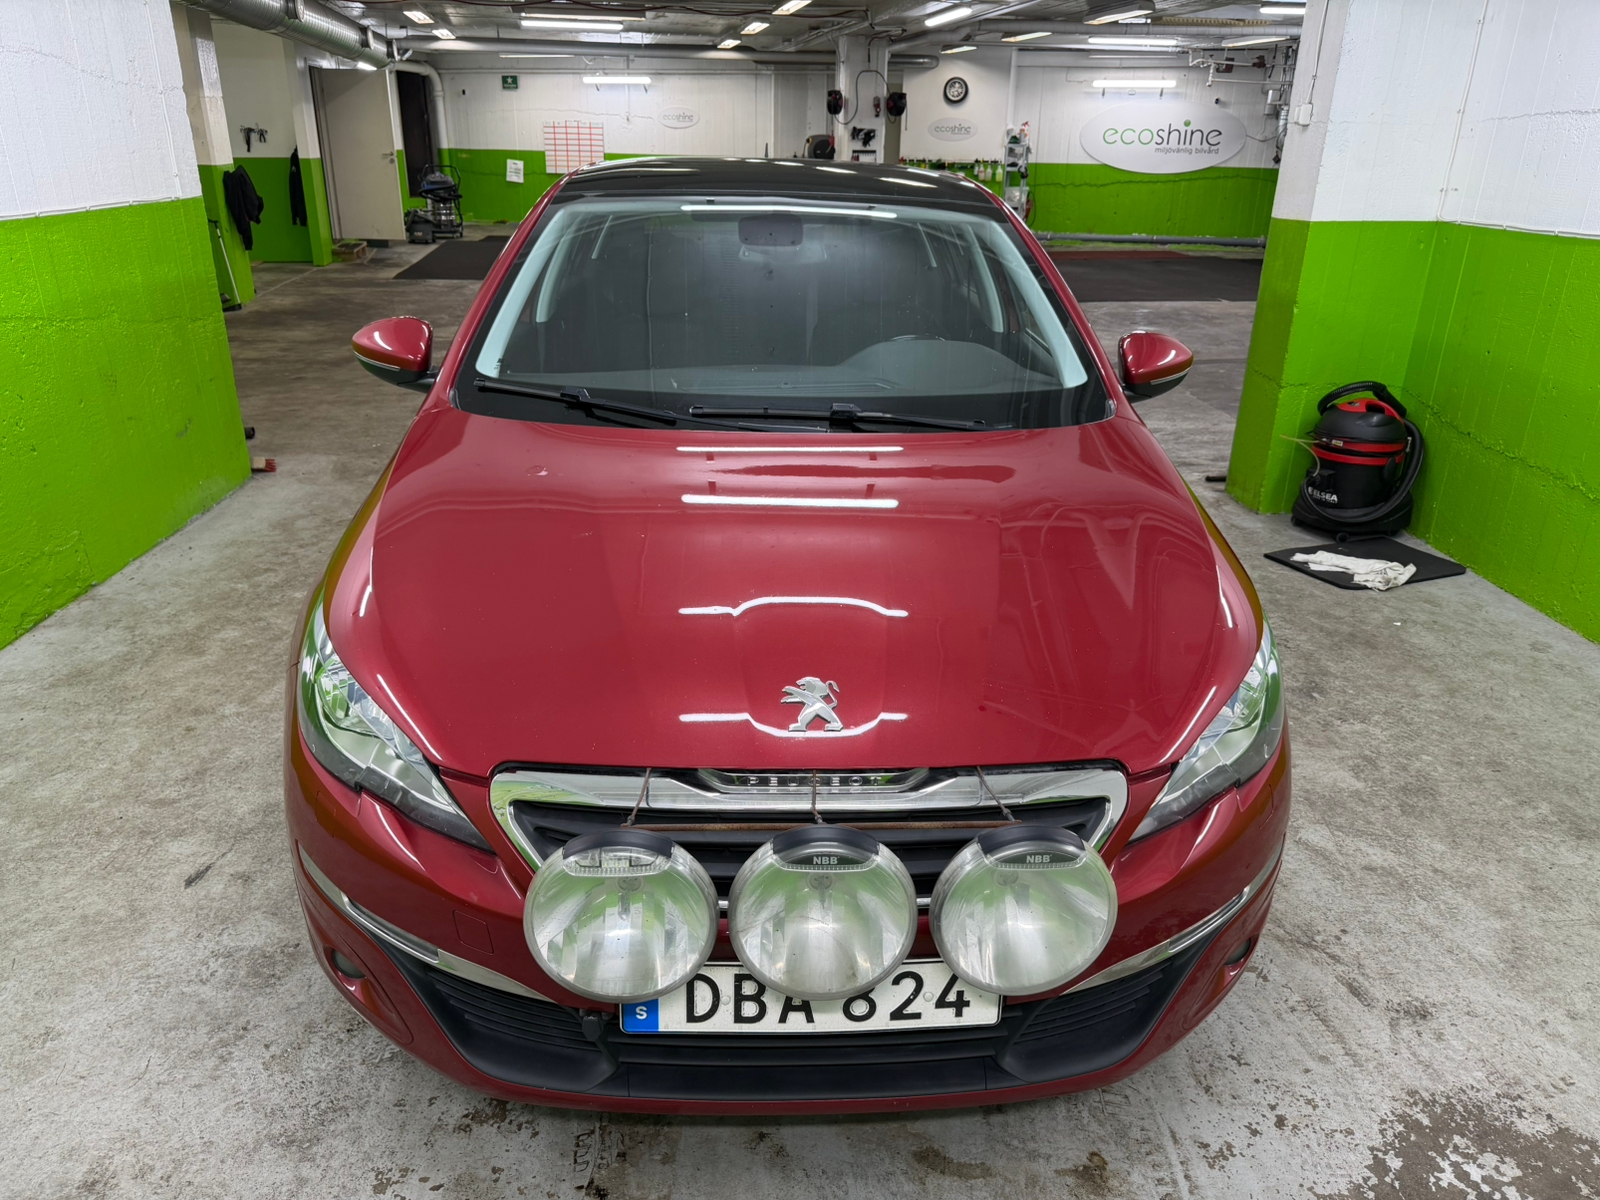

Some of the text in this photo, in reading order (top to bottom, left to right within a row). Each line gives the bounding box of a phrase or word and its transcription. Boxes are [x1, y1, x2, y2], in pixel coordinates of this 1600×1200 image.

[662, 112, 694, 122] ecoshine
[934, 123, 971, 134] ecoshine
[1102, 119, 1223, 147] ecoshine
[1154, 146, 1220, 155] miljövänlig bilvård
[747, 775, 882, 787] PEUGEOT
[812, 856, 838, 865] NBB
[1026, 854, 1051, 863] NBB
[635, 1006, 648, 1020] S
